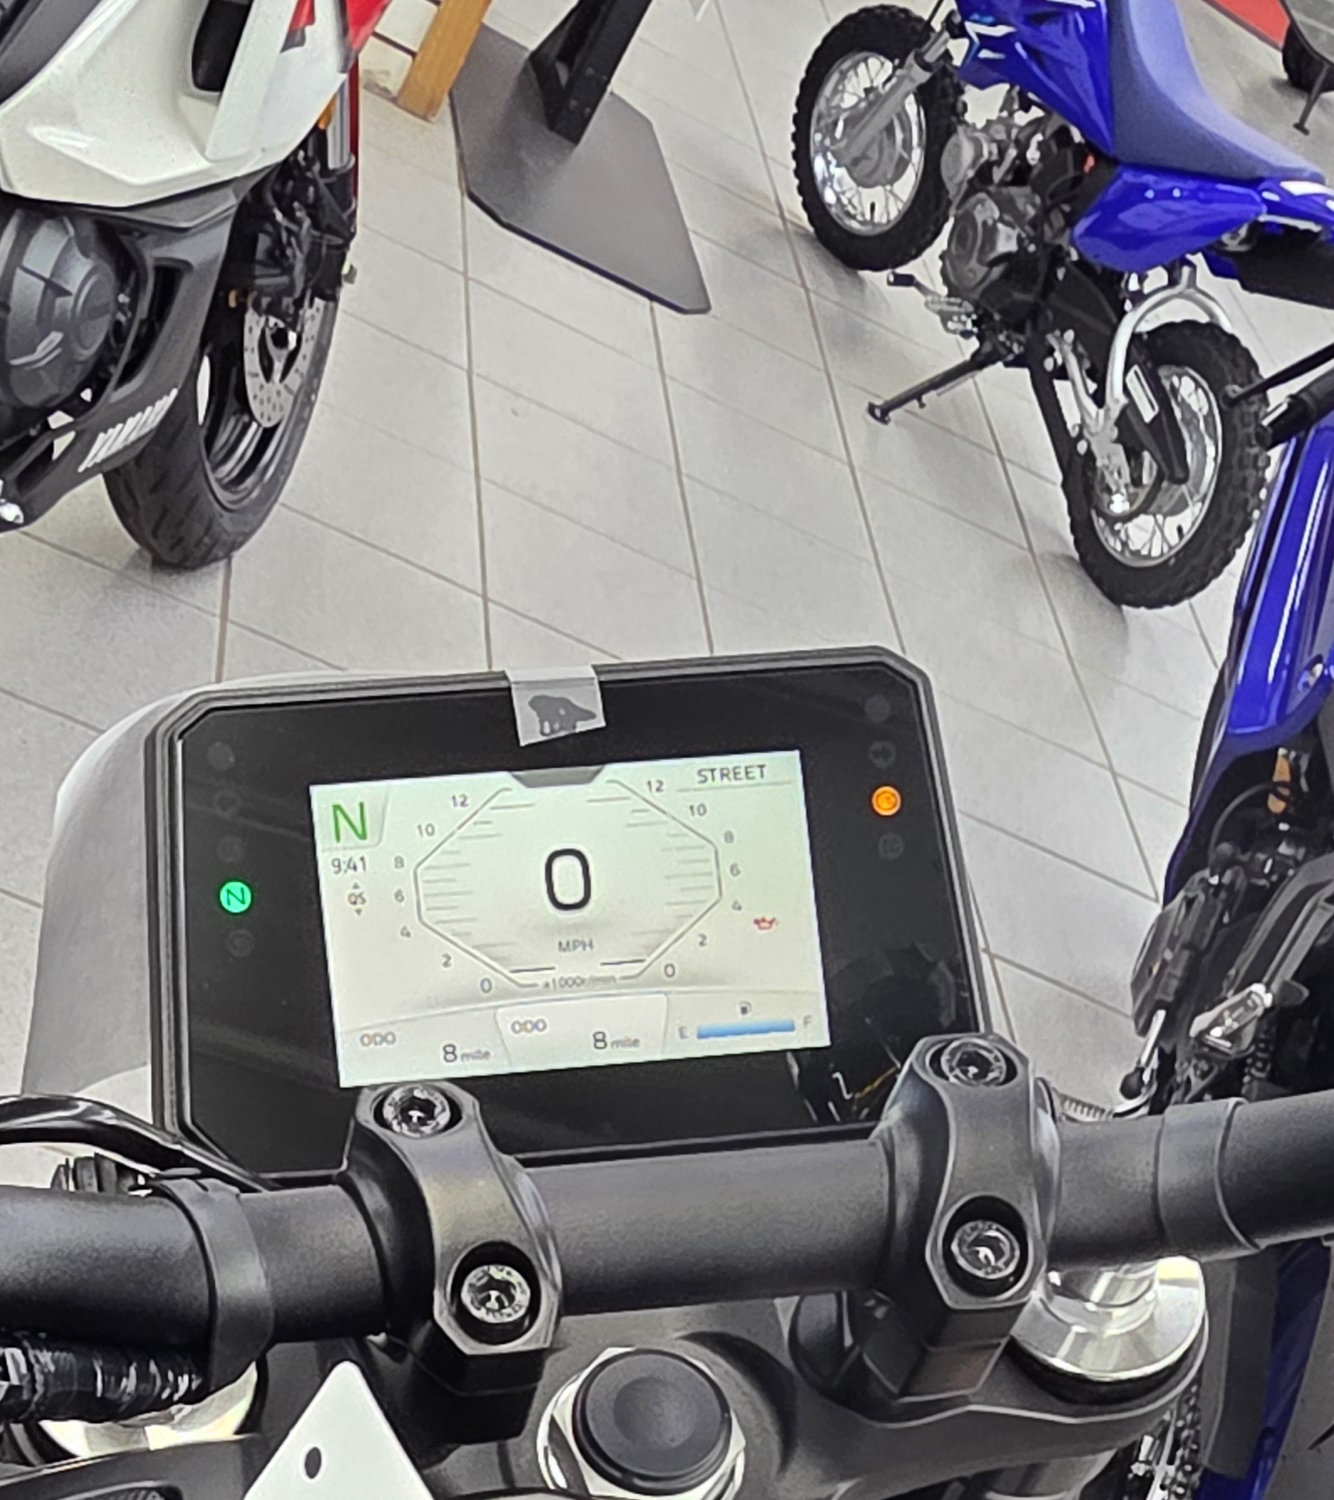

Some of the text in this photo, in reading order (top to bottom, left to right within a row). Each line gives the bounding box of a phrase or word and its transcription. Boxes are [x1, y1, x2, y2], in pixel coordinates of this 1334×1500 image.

[697, 764, 767, 783] STREET
[646, 779, 664, 793] 12
[452, 795, 469, 808] 12
[688, 803, 708, 818] 10
[331, 801, 368, 843] N
[416, 823, 436, 838] 10
[331, 855, 367, 875] 9:41
[545, 847, 591, 911] 0
[225, 886, 246, 907] N
[557, 939, 595, 953] MPH
[697, 934, 708, 947] 2
[441, 953, 452, 968] 2
[664, 963, 676, 978] 0
[480, 979, 492, 994] 0
[593, 1031, 608, 1050] 8
[442, 1043, 458, 1063] 8
